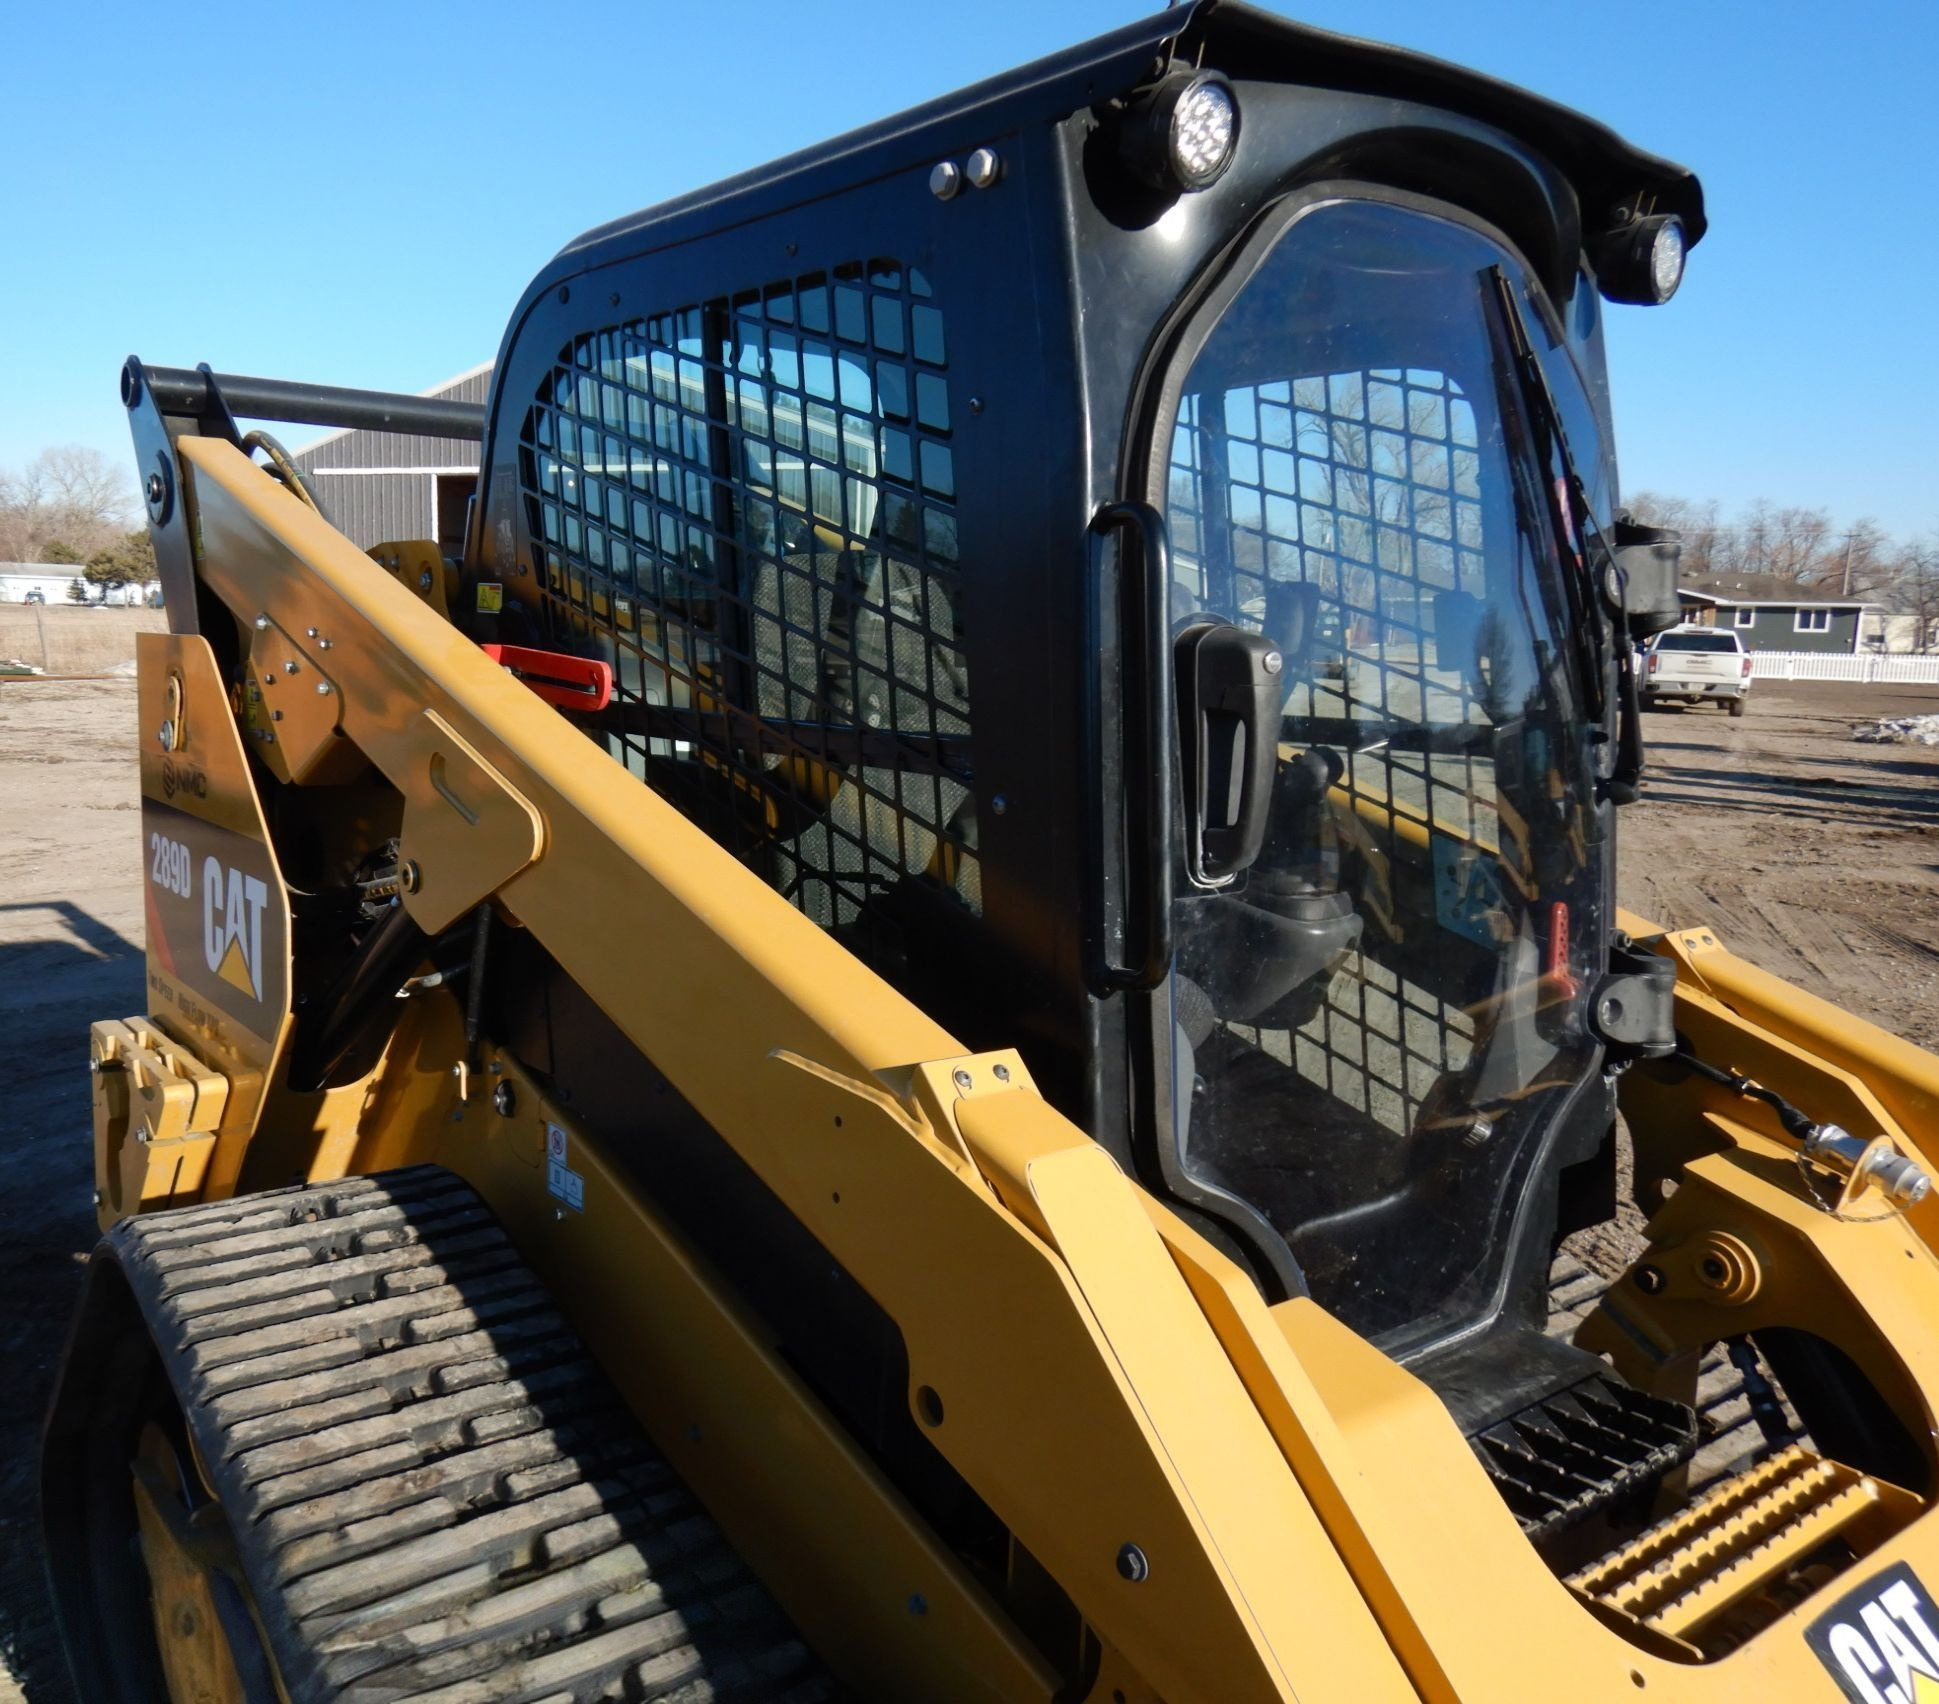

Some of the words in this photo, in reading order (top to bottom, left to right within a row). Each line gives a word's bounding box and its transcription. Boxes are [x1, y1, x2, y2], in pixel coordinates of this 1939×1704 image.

[175, 765, 207, 799] NMC
[151, 832, 191, 899] 289D
[203, 856, 267, 1003] CAT
[1829, 1579, 1939, 1704] CAT
